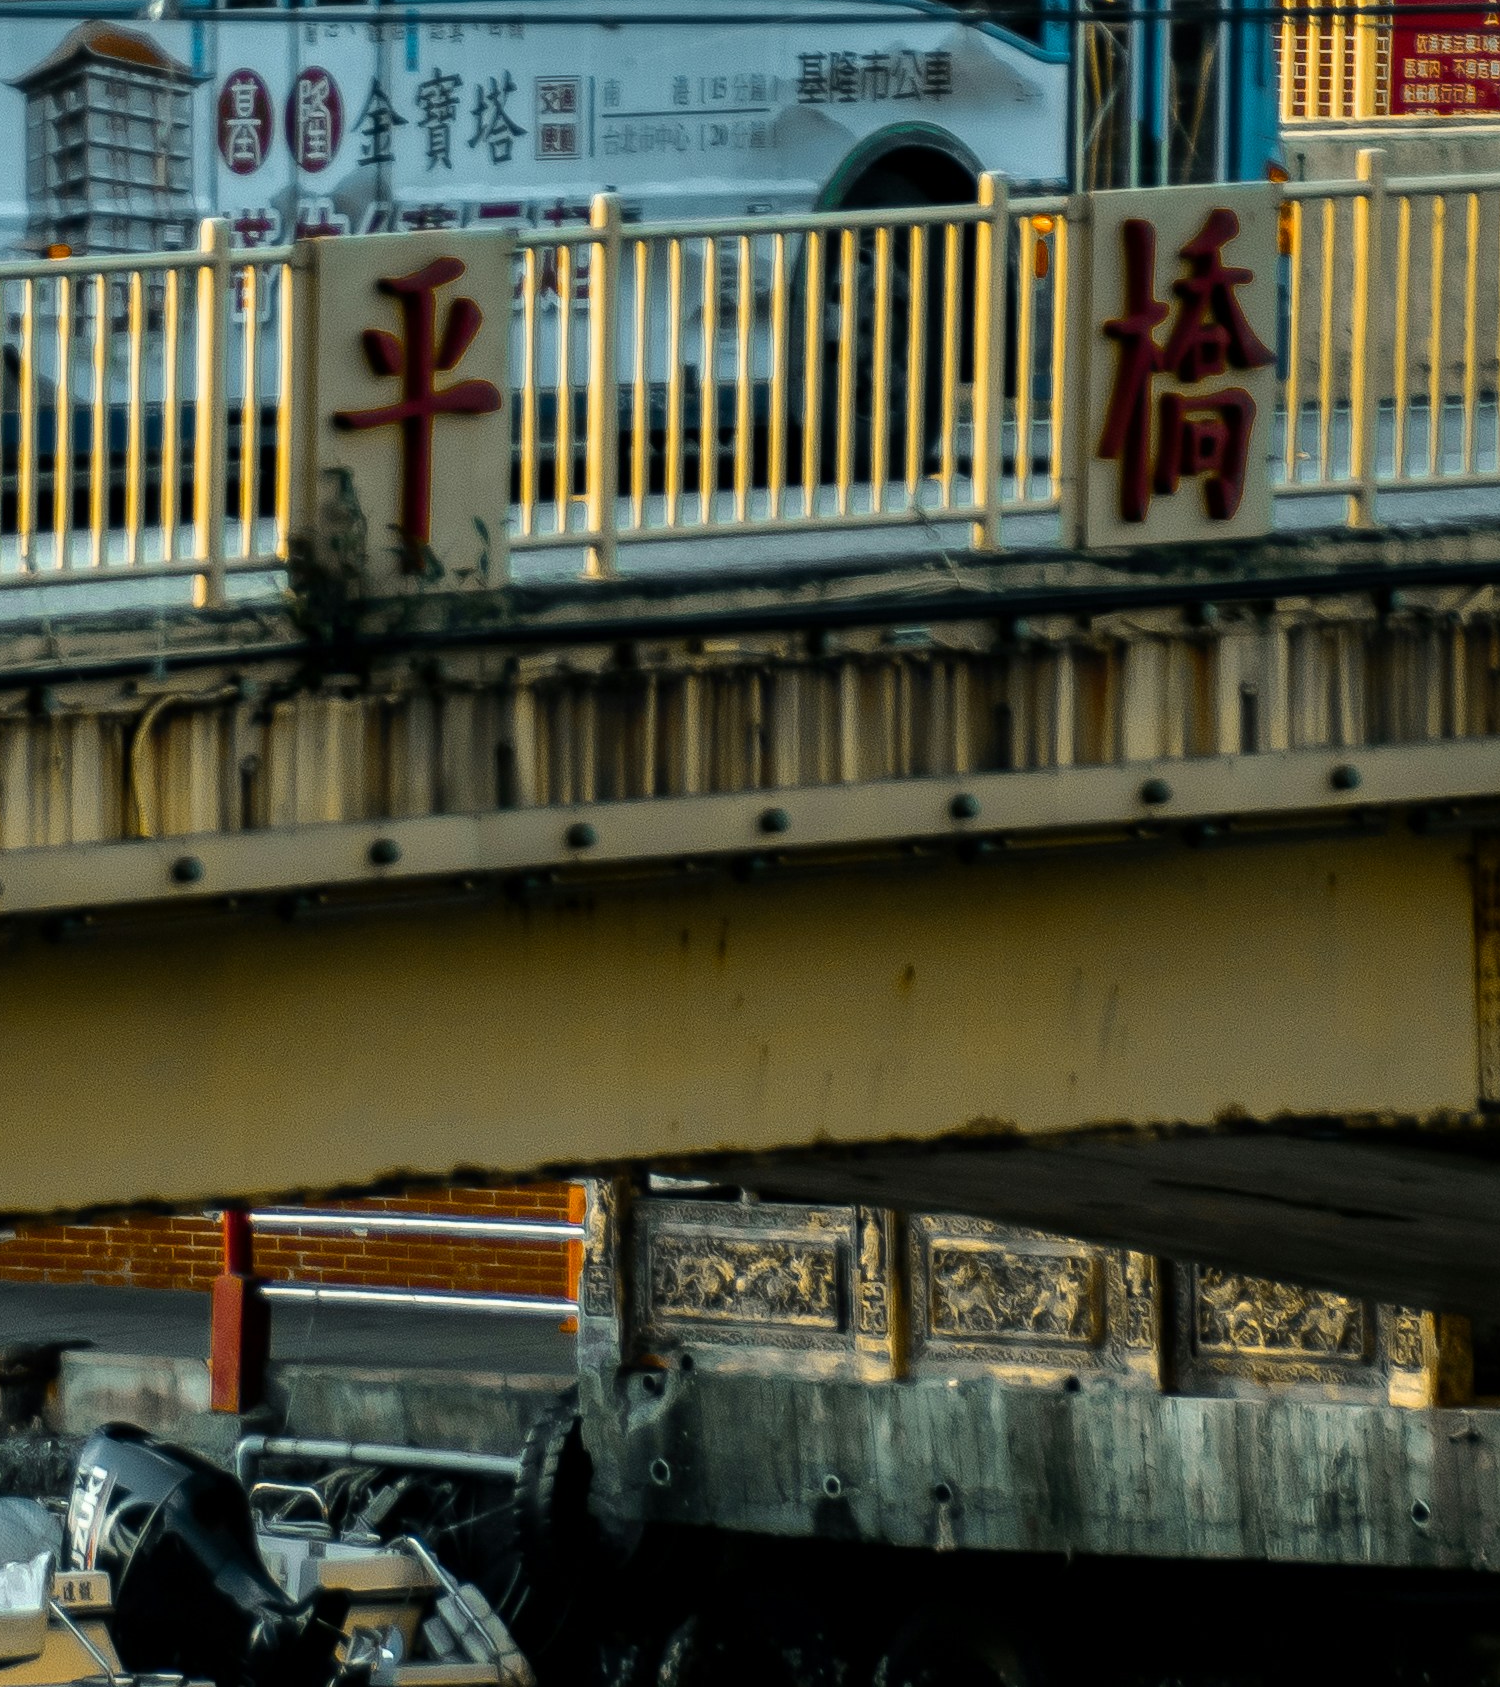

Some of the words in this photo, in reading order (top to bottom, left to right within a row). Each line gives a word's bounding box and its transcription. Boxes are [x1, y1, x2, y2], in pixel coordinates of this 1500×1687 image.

[217, 65, 529, 173] 基隆金寶塔
[797, 49, 953, 104] 基隆市公車
[331, 256, 503, 570] 平
[1098, 208, 1276, 522] 橋
[71, 1465, 107, 1571] UZUKI
